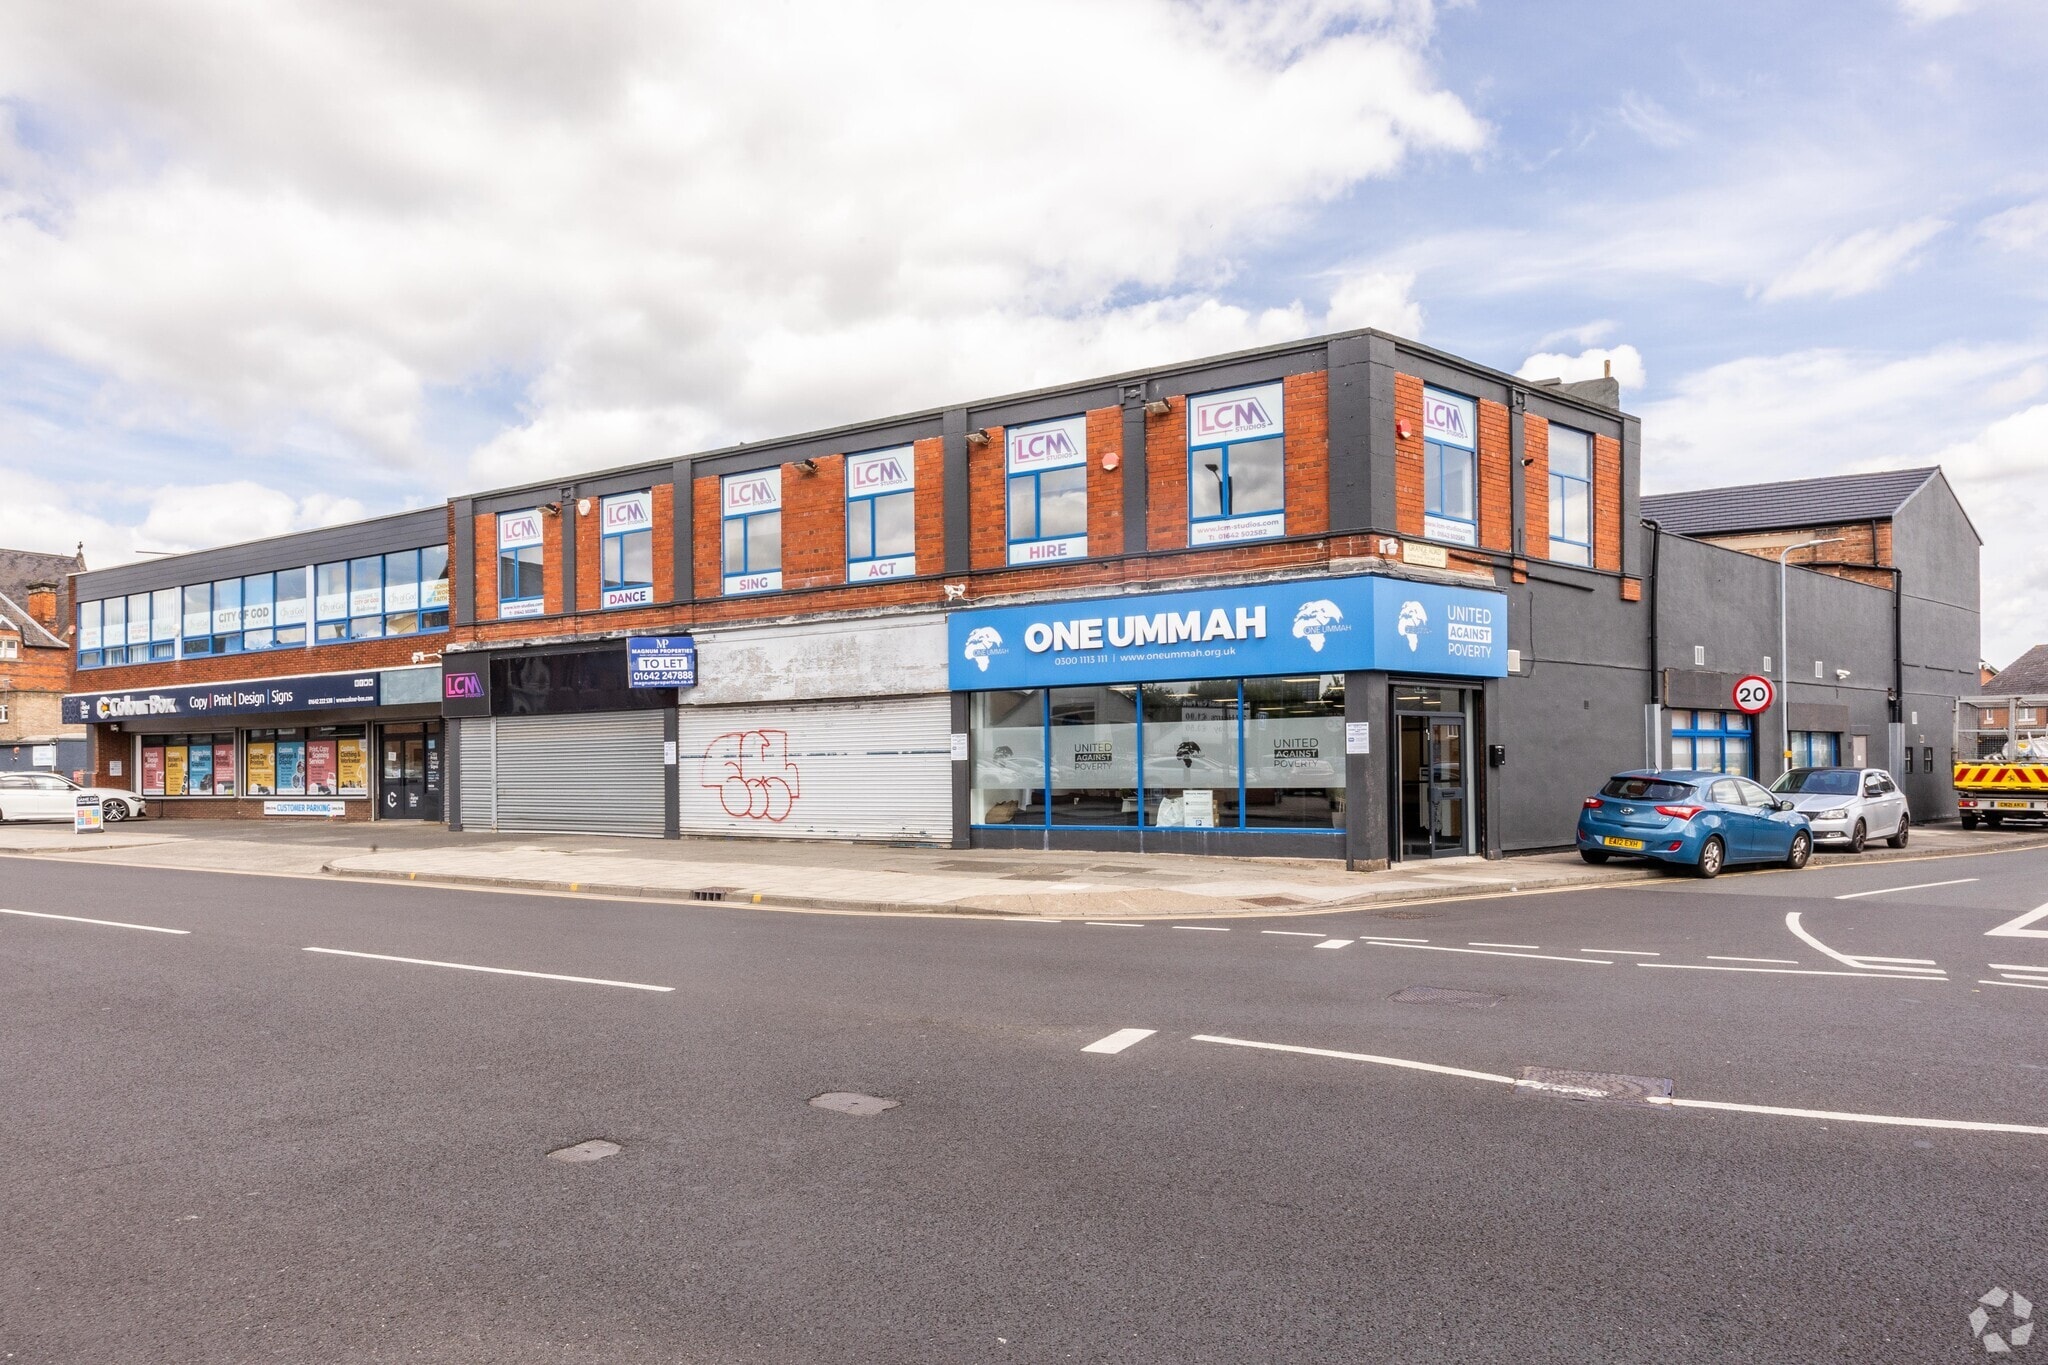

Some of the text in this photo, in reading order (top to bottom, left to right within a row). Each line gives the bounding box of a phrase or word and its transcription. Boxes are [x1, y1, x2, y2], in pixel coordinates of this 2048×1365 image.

[1202, 402, 1265, 432] LCM
[1426, 401, 1463, 433] LCM
[1235, 423, 1266, 432] STUDIOS
[1017, 432, 1071, 460] LCM
[1046, 453, 1073, 461] STUDIOS
[856, 461, 902, 485] LCM
[730, 483, 771, 505] LCM
[609, 503, 644, 524] LCM
[505, 519, 536, 539] LCM
[1197, 519, 1279, 534] www.lcm-studios.com
[1218, 530, 1240, 540] 01642
[1241, 528, 1267, 538] 502582
[1029, 543, 1067, 560] HIRE
[868, 562, 896, 577] ACT
[739, 577, 768, 591] SING
[609, 590, 646, 605] DANCE
[218, 607, 269, 623] CITY OF GOD
[1447, 604, 1492, 624] UNITED
[1024, 606, 1267, 653] ONE UMMAH
[1303, 624, 1352, 635] ONE UMMAH
[1449, 626, 1490, 641] AGAINST
[1054, 646, 1236, 666] 0300 1113 111 www.oneummah.org.uk
[1448, 642, 1492, 658] POVERTY
[642, 658, 683, 669] TO LET
[633, 670, 694, 680] 01642 247888
[448, 676, 480, 695] LCM
[633, 679, 694, 687] magnumproperties.co.uk
[189, 689, 293, 710] Copy Print Design Signs
[1739, 687, 1766, 702] 20
[110, 694, 177, 716] Colour Box
[1074, 743, 1112, 752] UNITED
[1273, 738, 1319, 748] UNITED
[1076, 754, 1111, 762] AGAINST
[1275, 749, 1317, 758] AGAINST
[1074, 763, 1113, 771] POVERTY
[1273, 759, 1319, 768] POVERTY
[276, 804, 305, 812] CUSTOMER
[306, 803, 331, 812] PARKING
[1608, 837, 1639, 847] EA12 EXH
